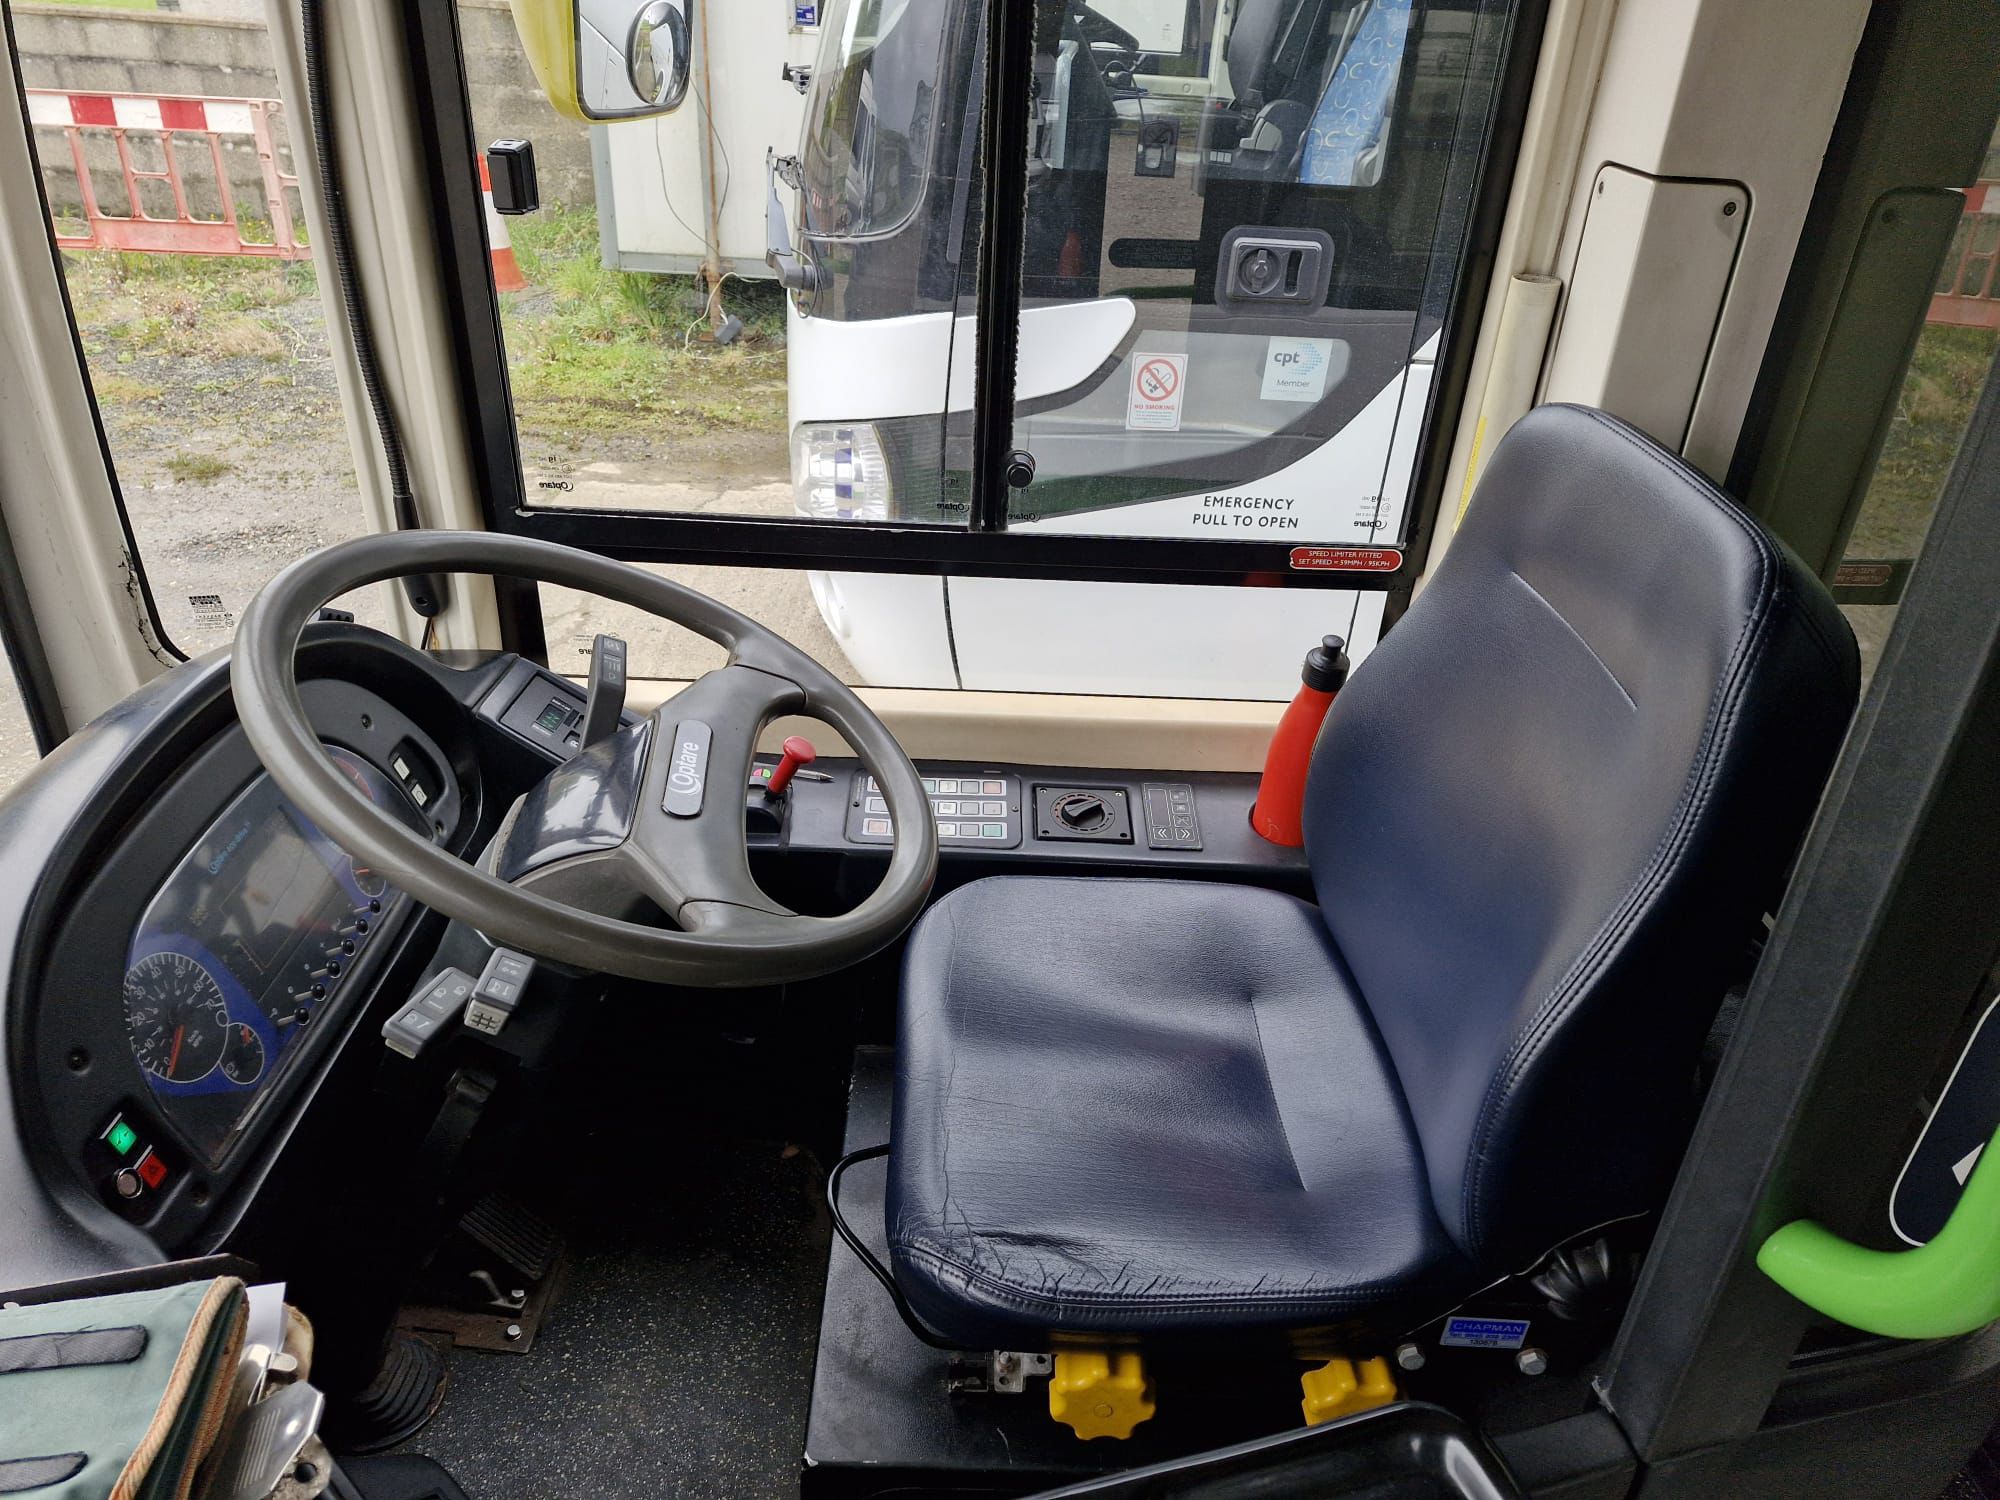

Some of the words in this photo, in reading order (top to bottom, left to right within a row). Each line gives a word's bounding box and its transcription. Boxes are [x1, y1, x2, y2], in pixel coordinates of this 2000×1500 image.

[1274, 351, 1300, 367] cpt
[1276, 379, 1310, 388] Member
[1203, 496, 1295, 511] EMERGENCY
[1192, 513, 1228, 526] PULL
[1233, 514, 1253, 527] TO
[1258, 516, 1299, 529] OPEN
[1330, 550, 1357, 558] LIMITER
[670, 742, 702, 796] Optare
[151, 966, 161, 979] 40
[1453, 1322, 1522, 1333] CHAPMAN
